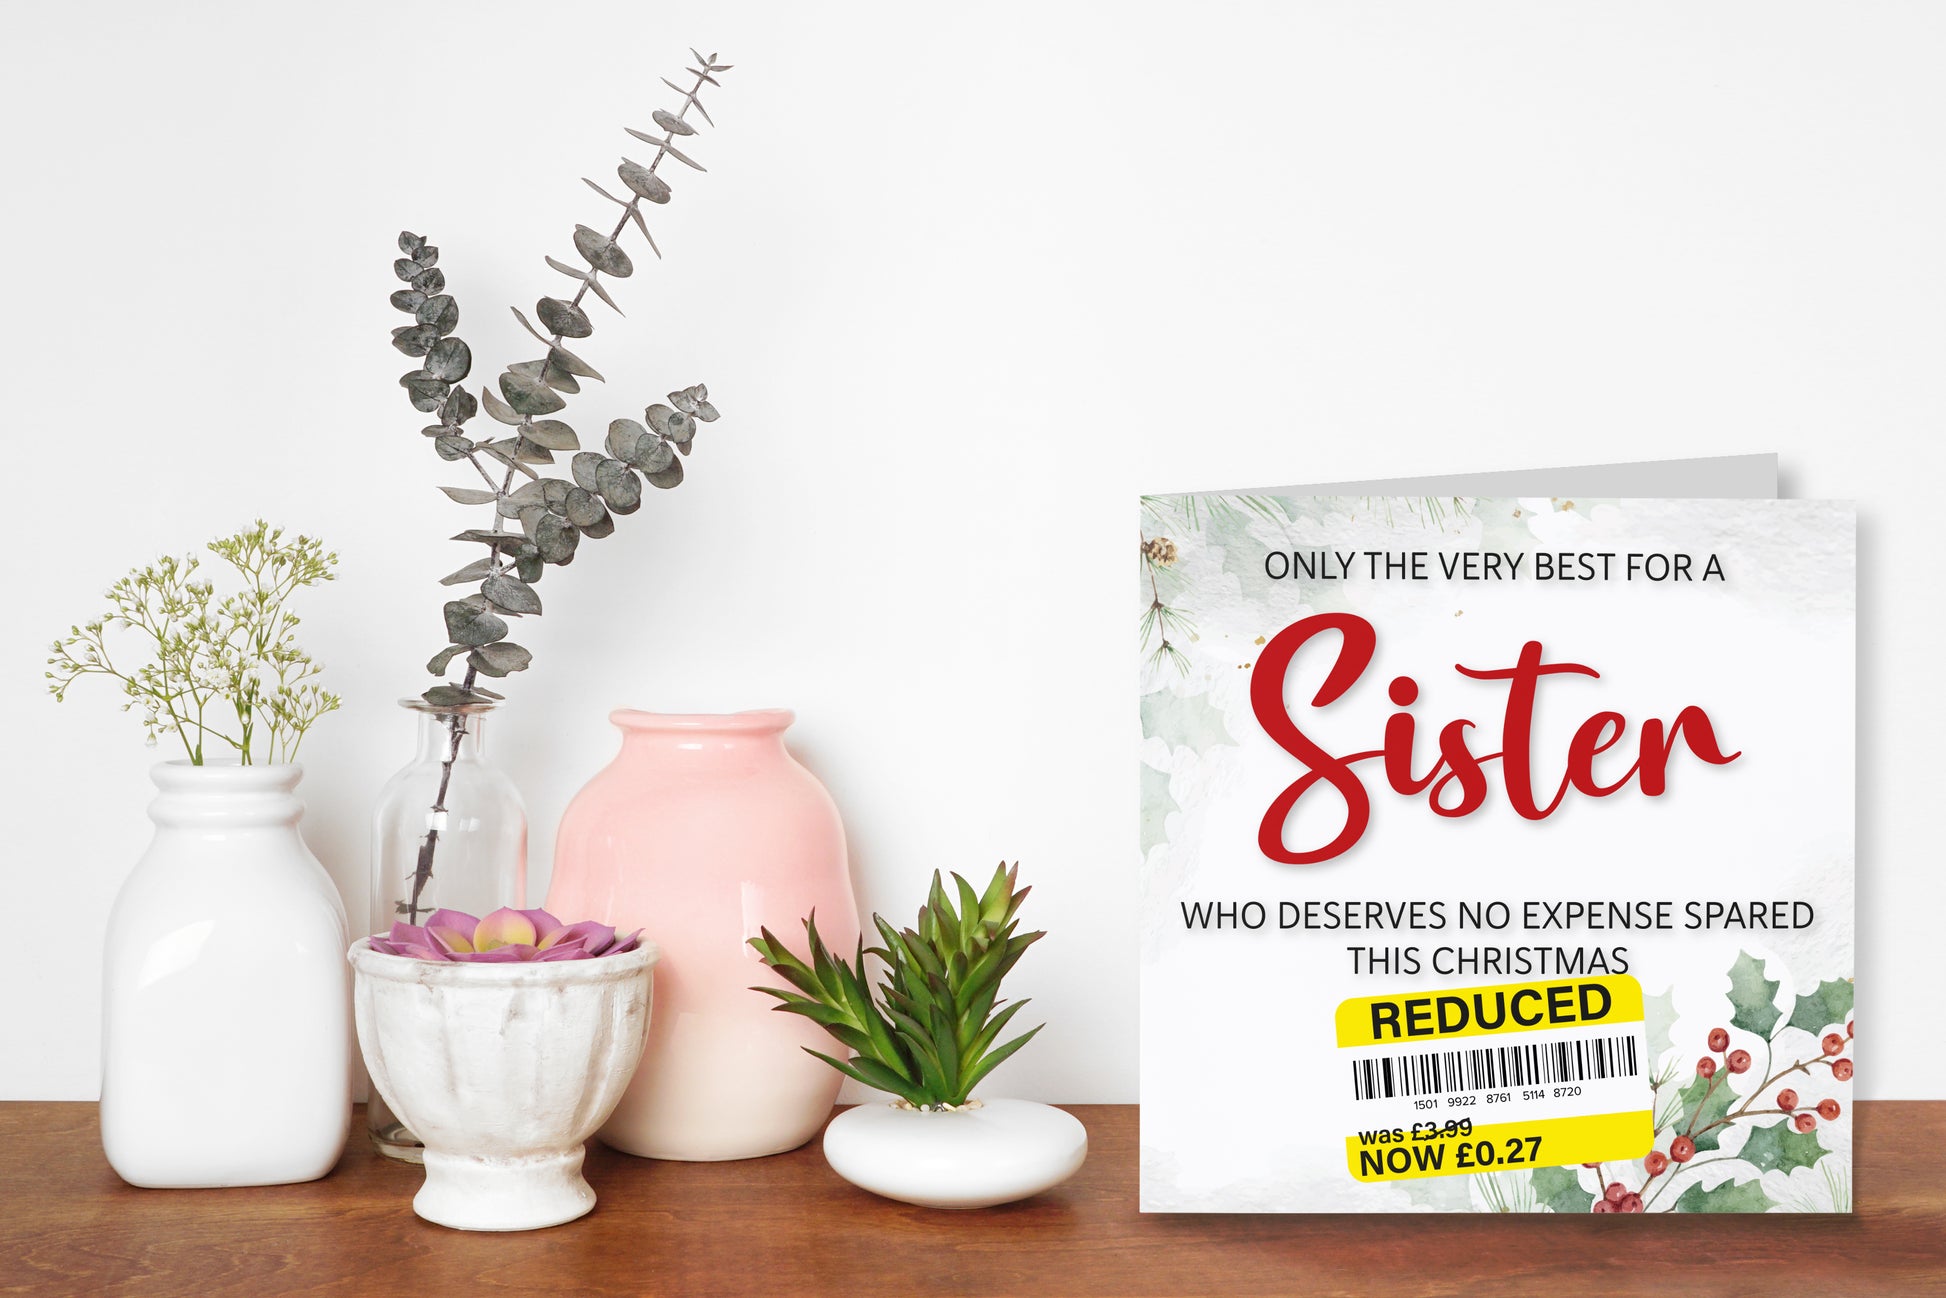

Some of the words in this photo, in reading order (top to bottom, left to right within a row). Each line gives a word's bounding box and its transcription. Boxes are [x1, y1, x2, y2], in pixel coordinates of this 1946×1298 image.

[1265, 551, 1356, 580] ONLY
[1363, 551, 1429, 580] THE
[1438, 552, 1525, 580] VERY
[1535, 552, 1616, 581] BEST
[1627, 553, 1693, 582] FOR
[1702, 553, 1726, 582] A
[1249, 612, 1742, 865] Sister
[1180, 901, 1266, 930] WHO
[1279, 901, 1446, 930] DESERVES
[1459, 901, 1510, 930] NO
[1523, 901, 1673, 930] EXPENSE
[1684, 901, 1814, 930] SPARED
[1346, 946, 1421, 975] THIS
[1432, 946, 1629, 975] CHRISTMAS
[1370, 983, 1612, 1040] REDUCED
[1413, 1098, 1439, 1110] 1501
[1447, 1095, 1476, 1107] 9922
[1486, 1092, 1511, 1104] 8761
[1522, 1089, 1545, 1101] 5114
[1553, 1086, 1582, 1098] 8720
[1358, 1128, 1405, 1146] was
[1411, 1117, 1473, 1141] £3.99
[1359, 1143, 1446, 1177] NOW
[1455, 1136, 1543, 1169] £0.27
